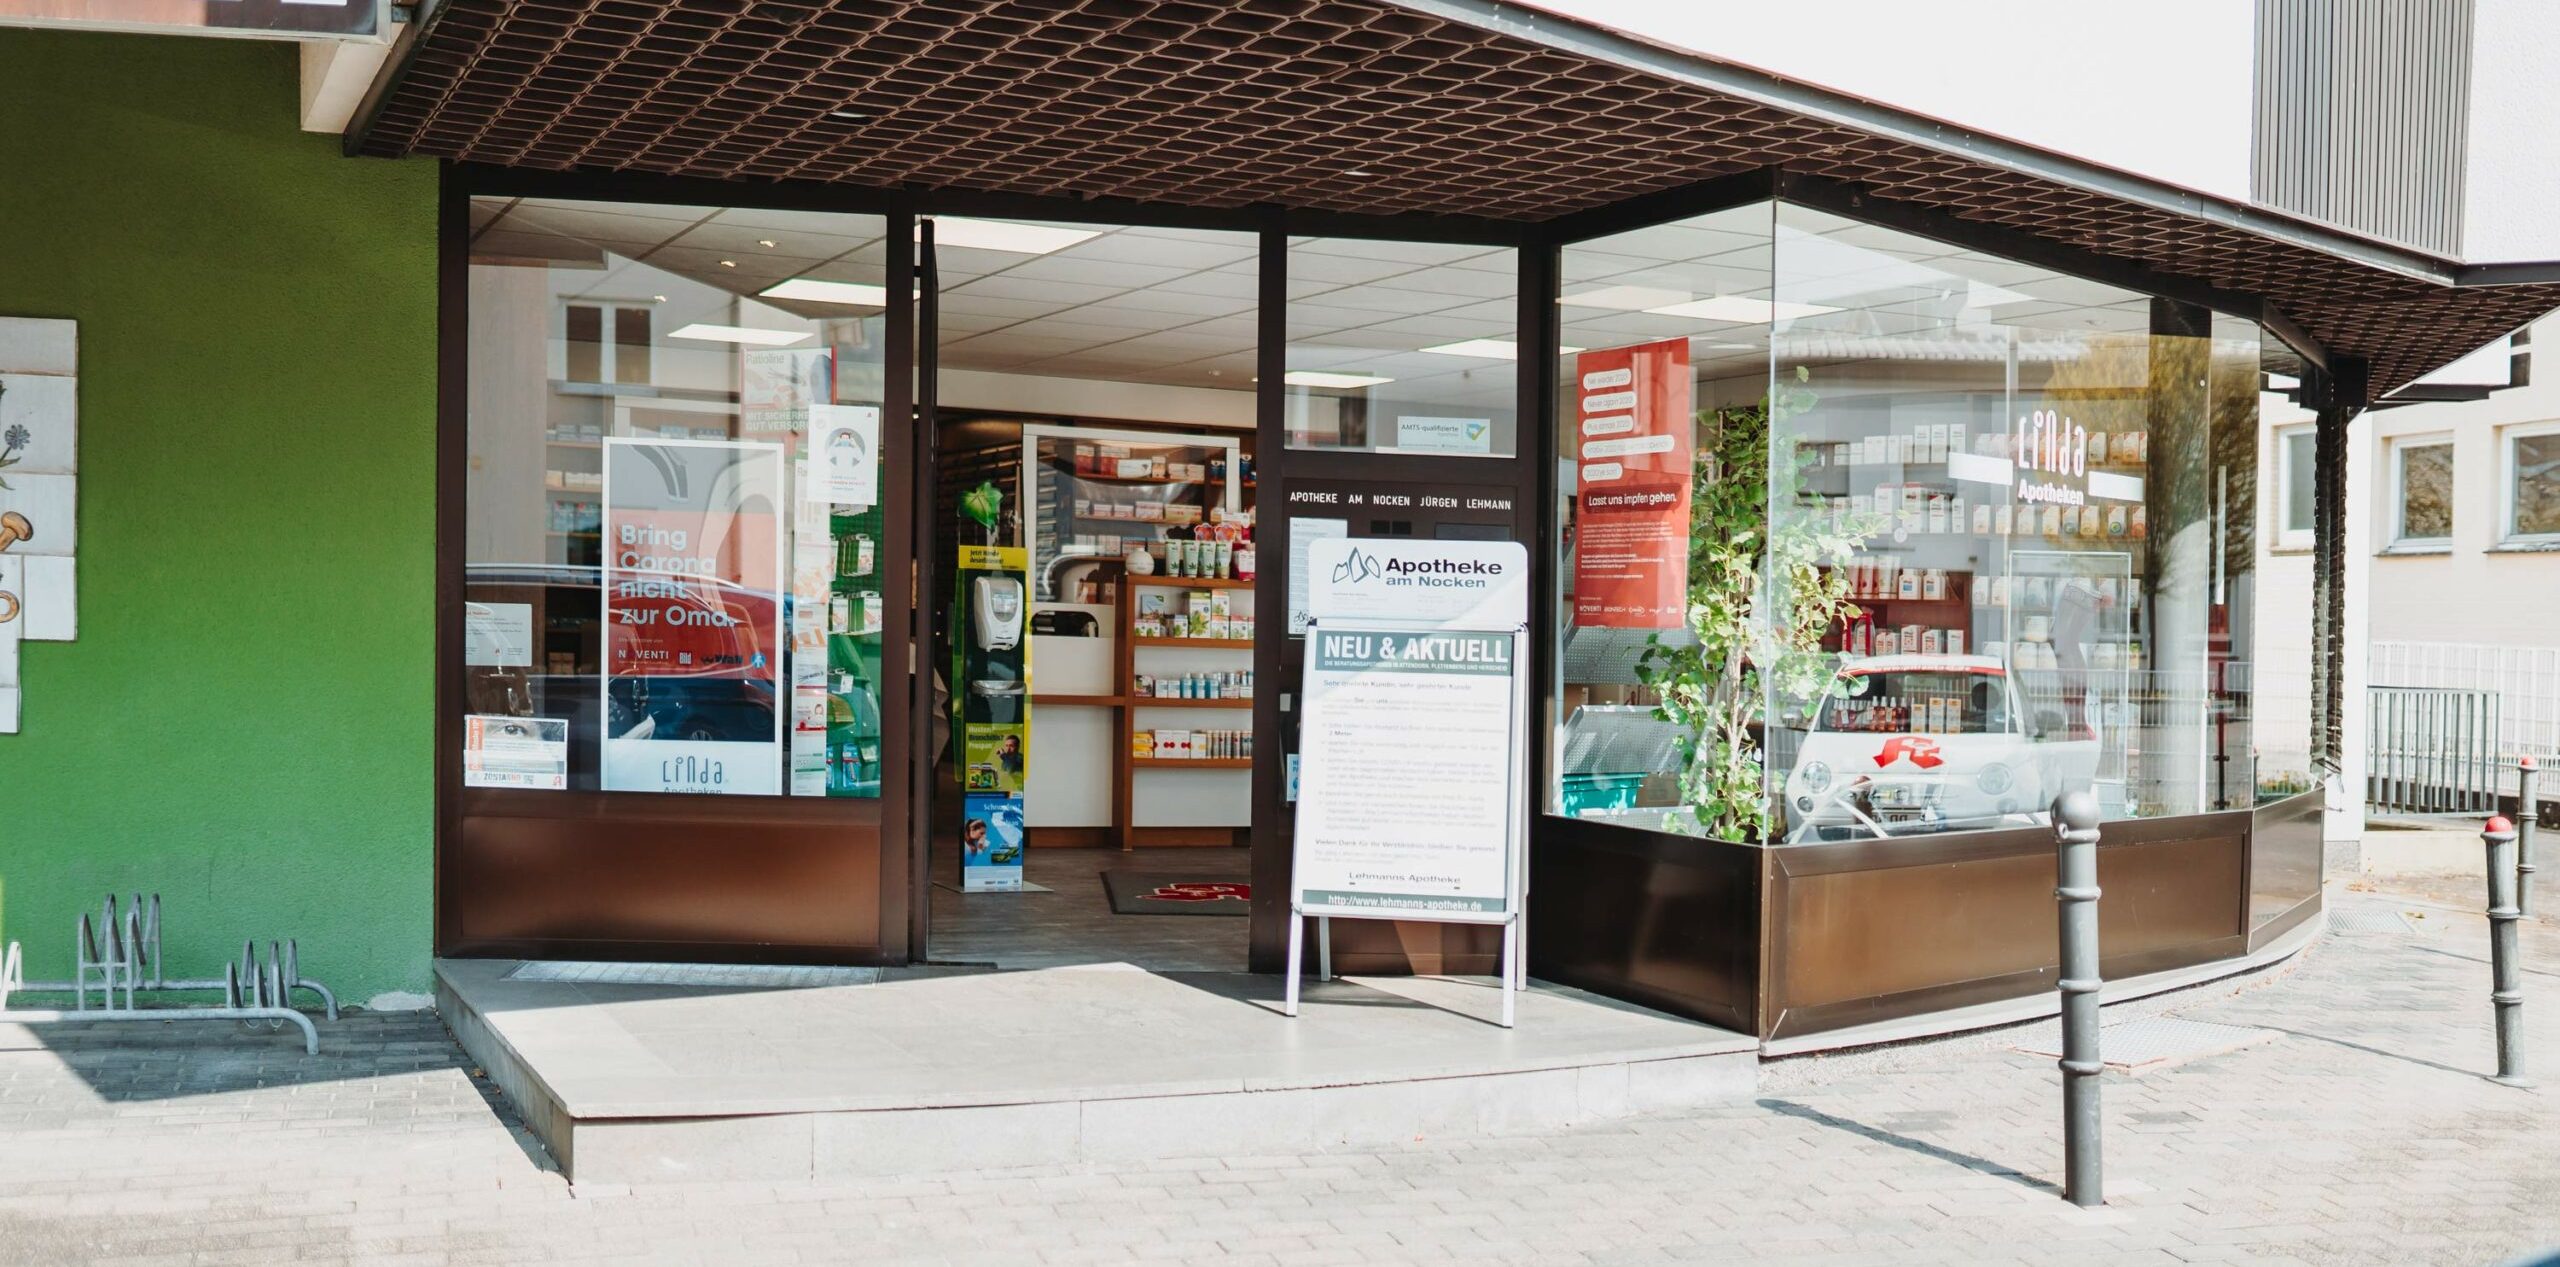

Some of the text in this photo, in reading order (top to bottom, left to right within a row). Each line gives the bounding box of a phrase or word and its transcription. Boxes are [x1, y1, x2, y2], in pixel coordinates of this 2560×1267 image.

[1289, 491, 1511, 510] APOTHEKE AM NOCKEN JÜRGEN LEHMANN
[1588, 491, 1676, 507] Lasst uns impfen gehen.
[2018, 478, 2084, 506] Apotheken
[621, 524, 687, 551] Bring
[620, 551, 717, 573] Corona
[1385, 558, 1502, 575] Apotheke
[620, 578, 687, 600] nicht
[1385, 576, 1486, 588] am Nocken
[620, 604, 736, 627] zur Oma.
[618, 649, 669, 660] NVENTI
[1324, 635, 1509, 663] NEU & AKTUELL
[1349, 871, 1405, 882] Lehmanns
[1408, 873, 1461, 885] Apotheke
[1328, 894, 1482, 912] http://www.lehmanns-apotheke.de
